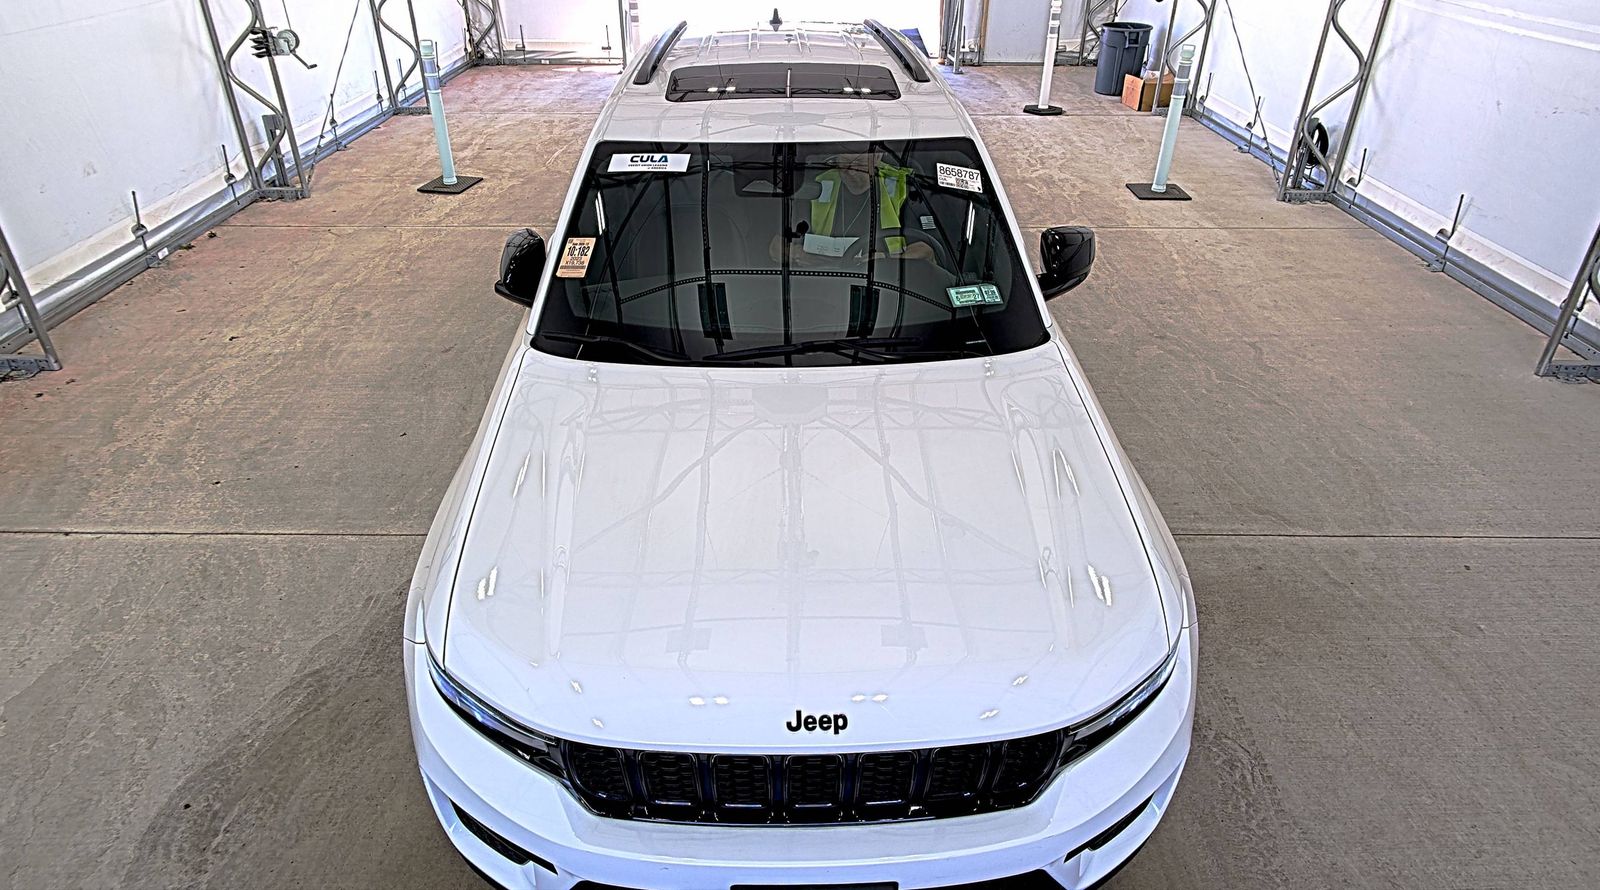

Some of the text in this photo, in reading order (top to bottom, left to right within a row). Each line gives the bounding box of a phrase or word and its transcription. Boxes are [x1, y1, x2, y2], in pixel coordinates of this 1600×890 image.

[630, 155, 669, 163] CULA
[939, 165, 980, 181] 8658787
[567, 245, 591, 257] 10:182
[786, 709, 848, 735] Jeep
